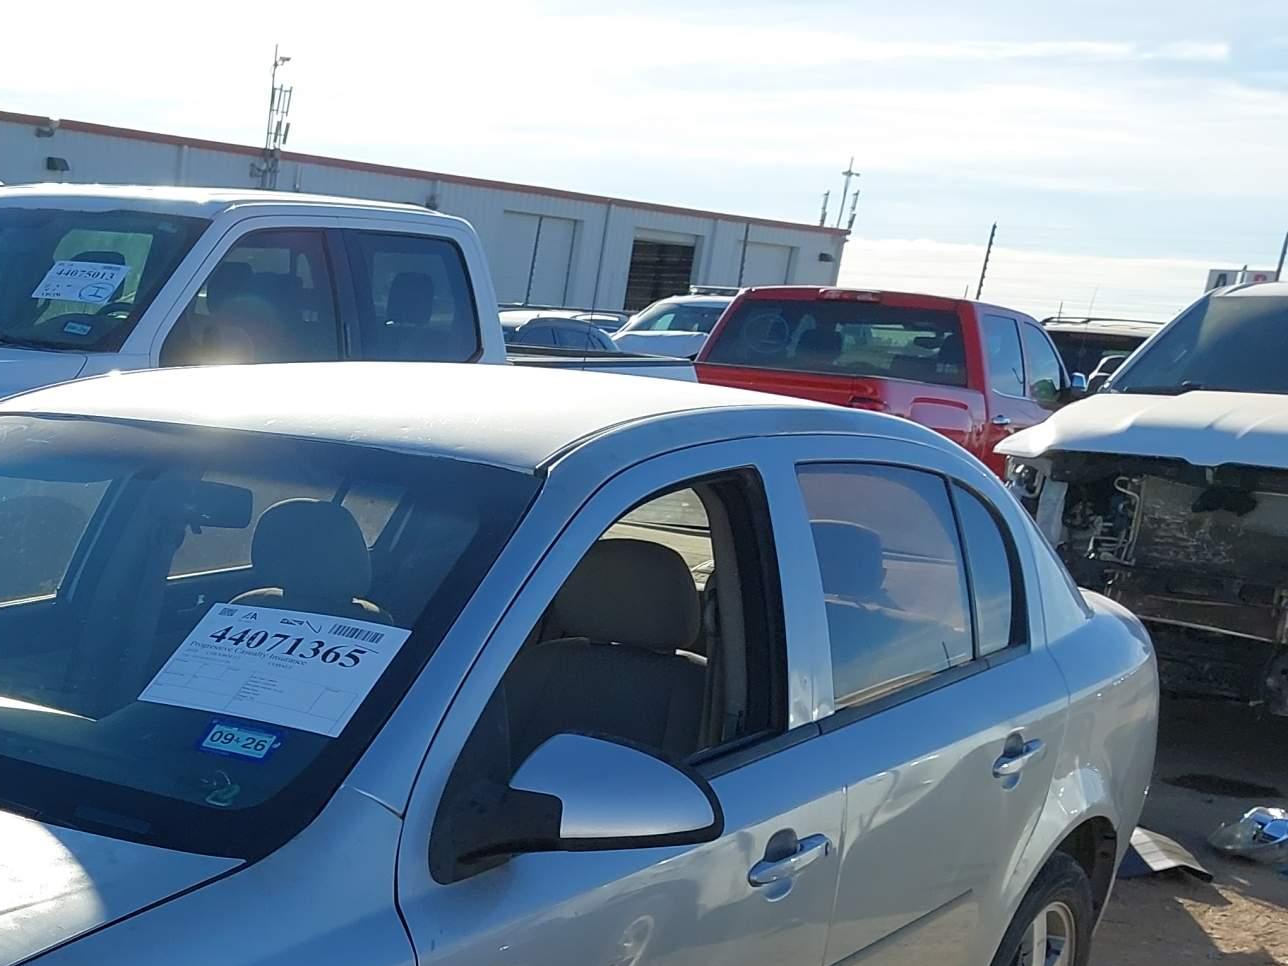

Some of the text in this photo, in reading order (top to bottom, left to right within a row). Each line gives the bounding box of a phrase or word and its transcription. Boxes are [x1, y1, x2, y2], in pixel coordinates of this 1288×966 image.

[209, 625, 368, 668] 44071365
[209, 730, 268, 752] 09 26
